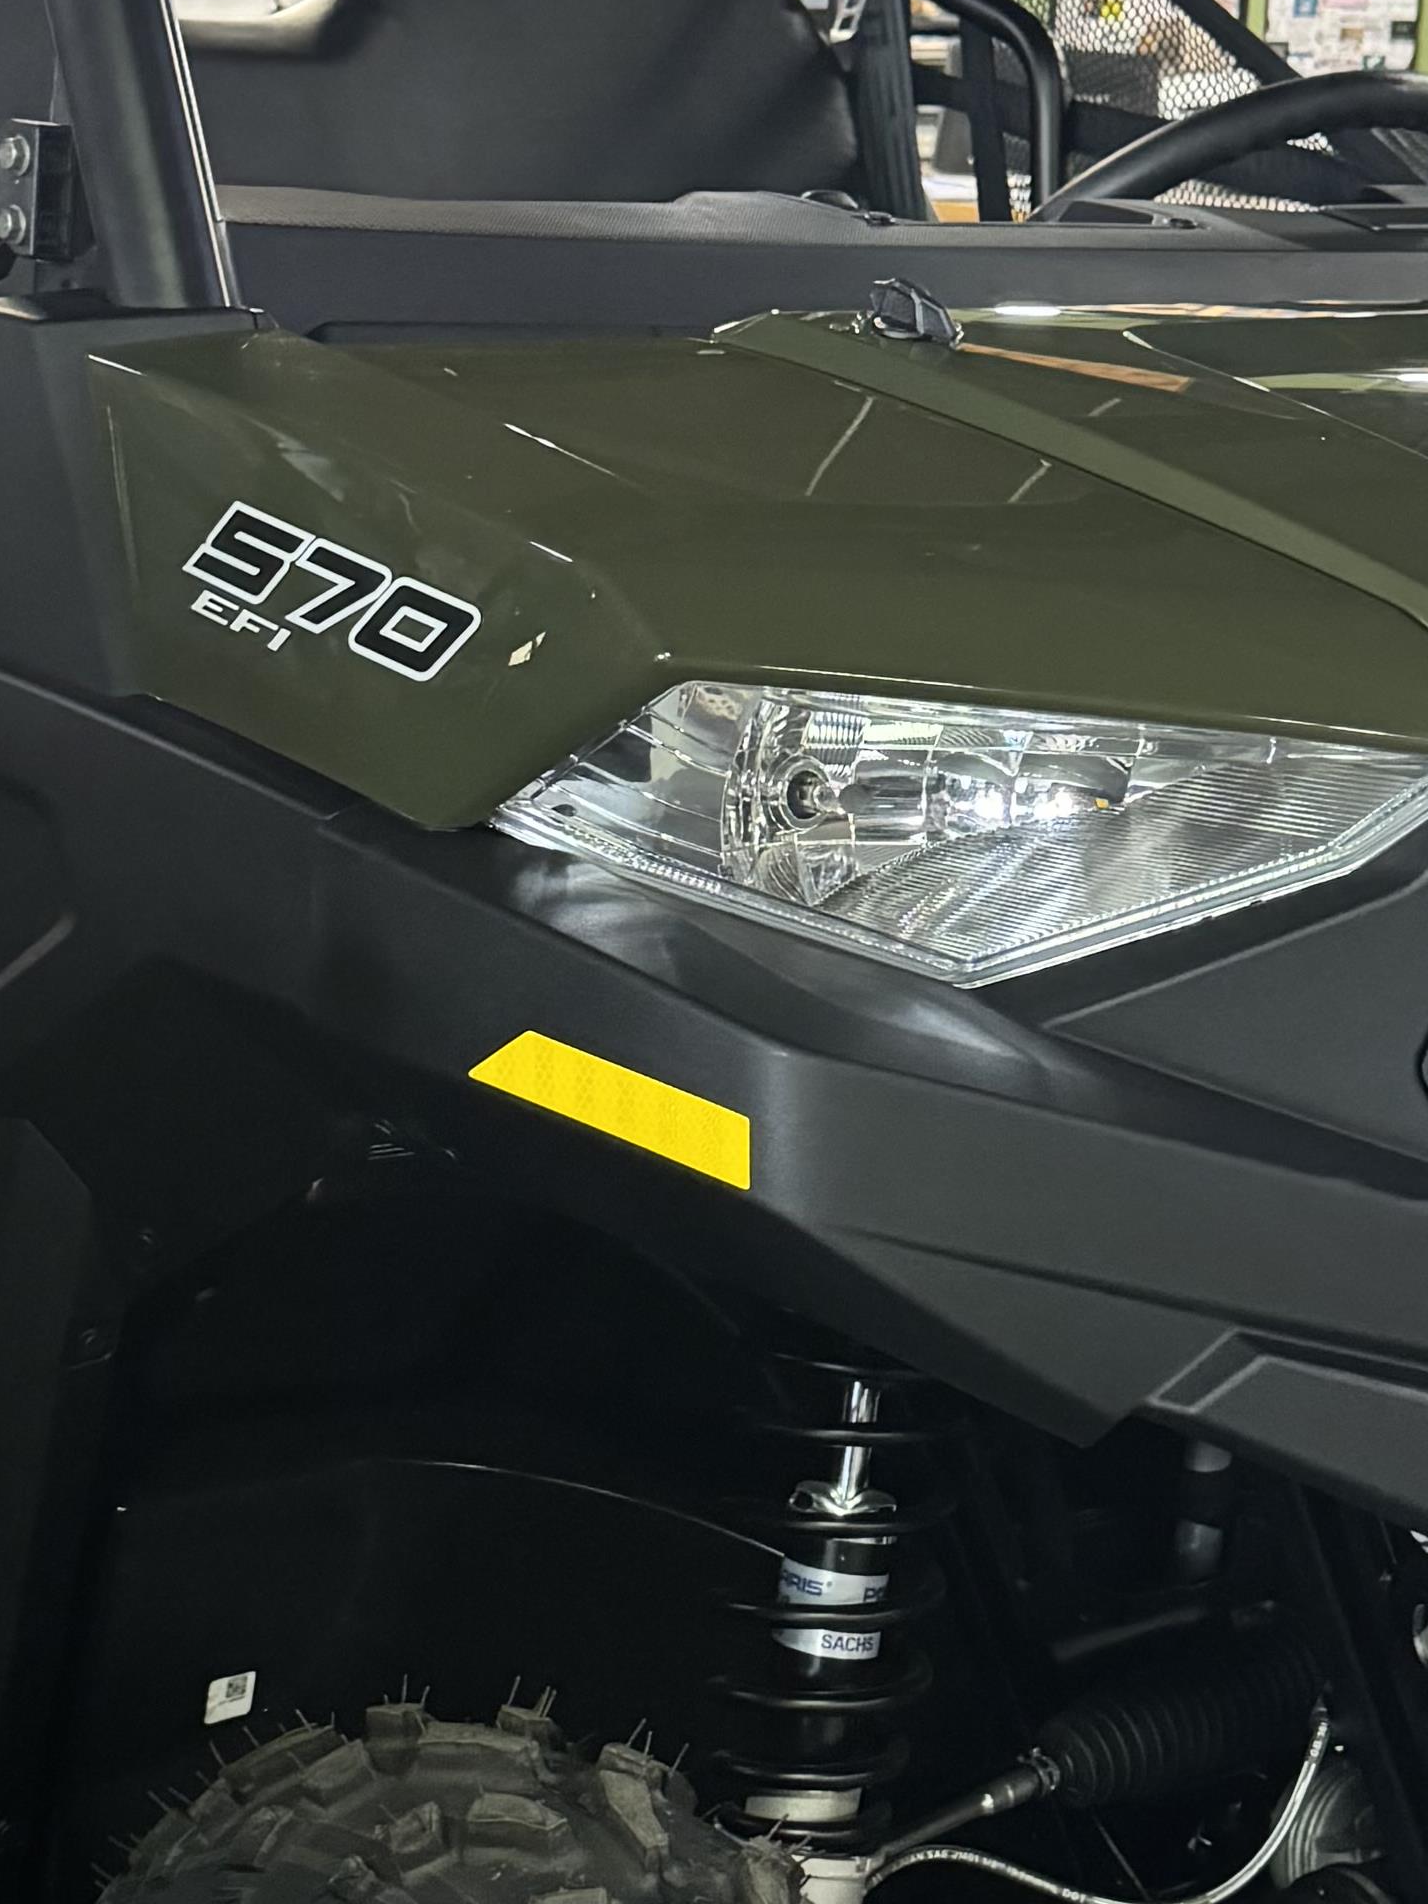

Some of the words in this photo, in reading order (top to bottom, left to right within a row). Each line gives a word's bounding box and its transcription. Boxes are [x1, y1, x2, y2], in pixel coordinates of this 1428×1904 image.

[181, 500, 482, 682] 570
[190, 589, 293, 652] EFI
[820, 1633, 875, 1653] SACHS
